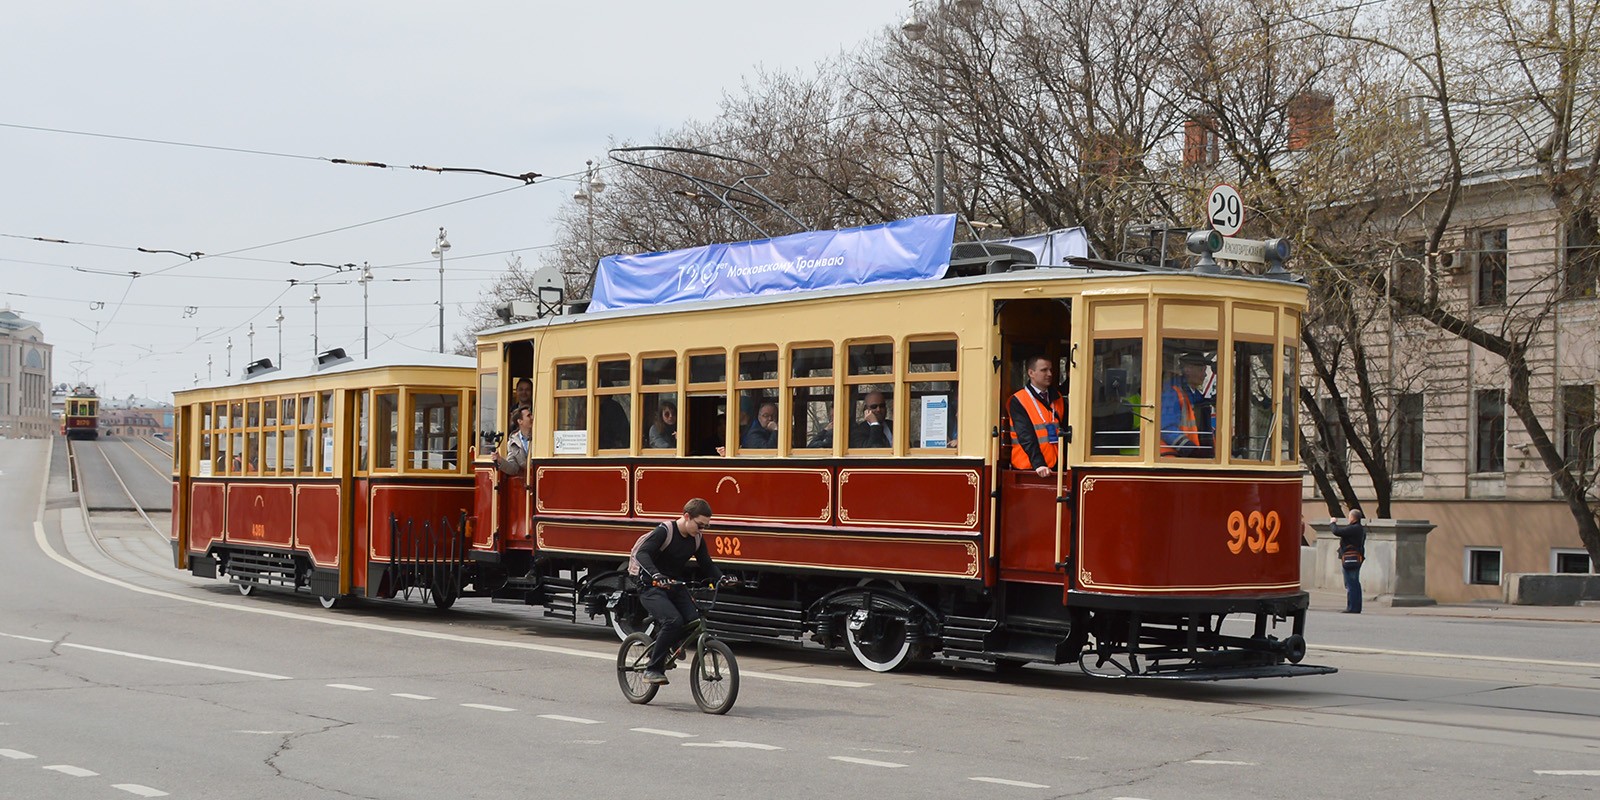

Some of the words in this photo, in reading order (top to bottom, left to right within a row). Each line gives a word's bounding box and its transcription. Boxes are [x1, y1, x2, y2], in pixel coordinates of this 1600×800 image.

[1212, 192, 1240, 228] 29
[677, 261, 720, 292] 120
[727, 261, 794, 278] Московскому
[796, 255, 844, 272] Трамваю
[715, 535, 741, 556] 932
[1227, 510, 1281, 555] 932
